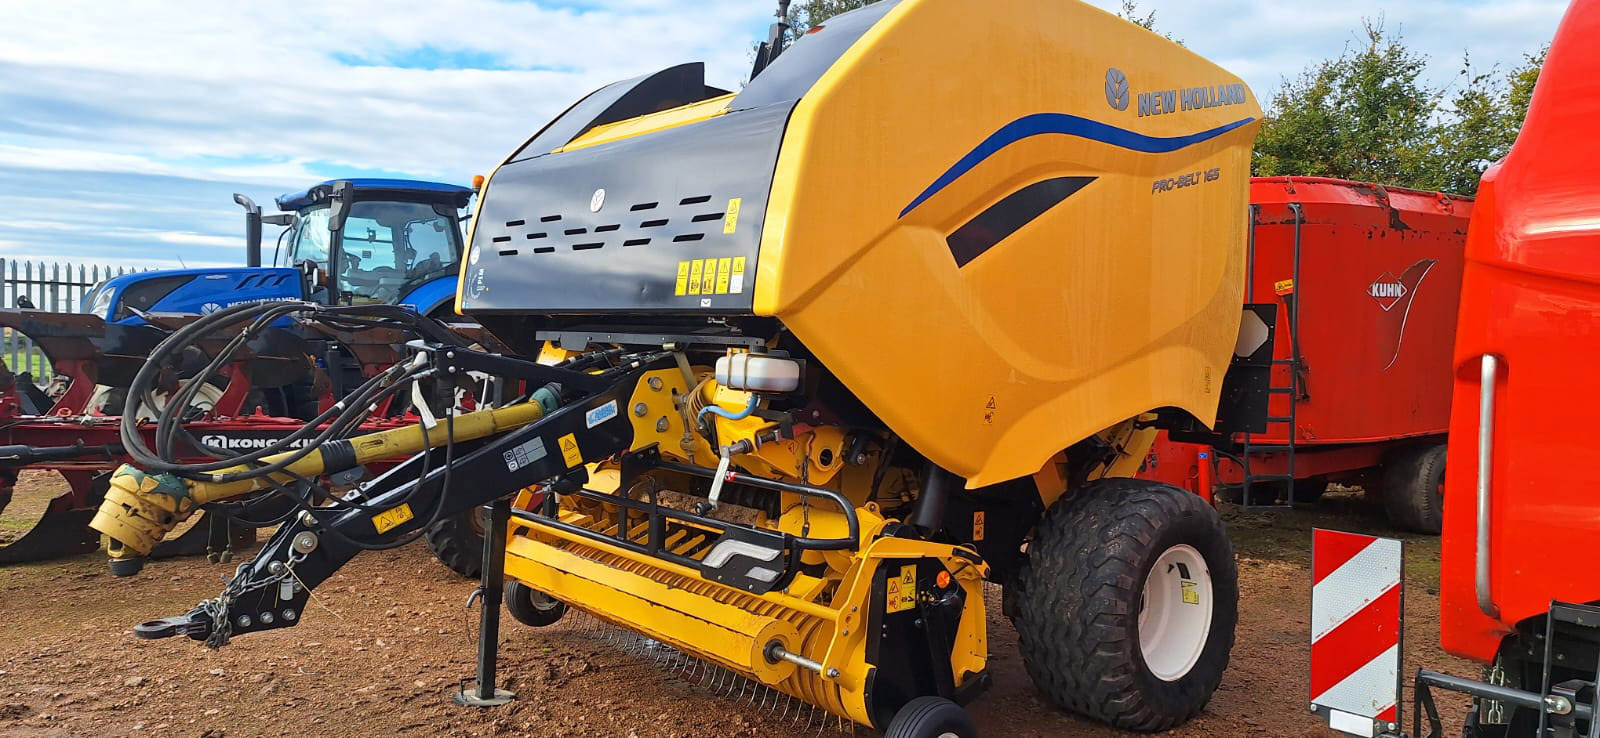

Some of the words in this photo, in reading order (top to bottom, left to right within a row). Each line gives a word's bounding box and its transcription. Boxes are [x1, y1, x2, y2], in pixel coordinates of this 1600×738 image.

[1138, 90, 1176, 117] NEW
[1180, 83, 1246, 111] HOLLAND
[1152, 171, 1201, 195] PRO-BELT
[1203, 168, 1220, 183] 165
[1372, 283, 1402, 297] KUHN
